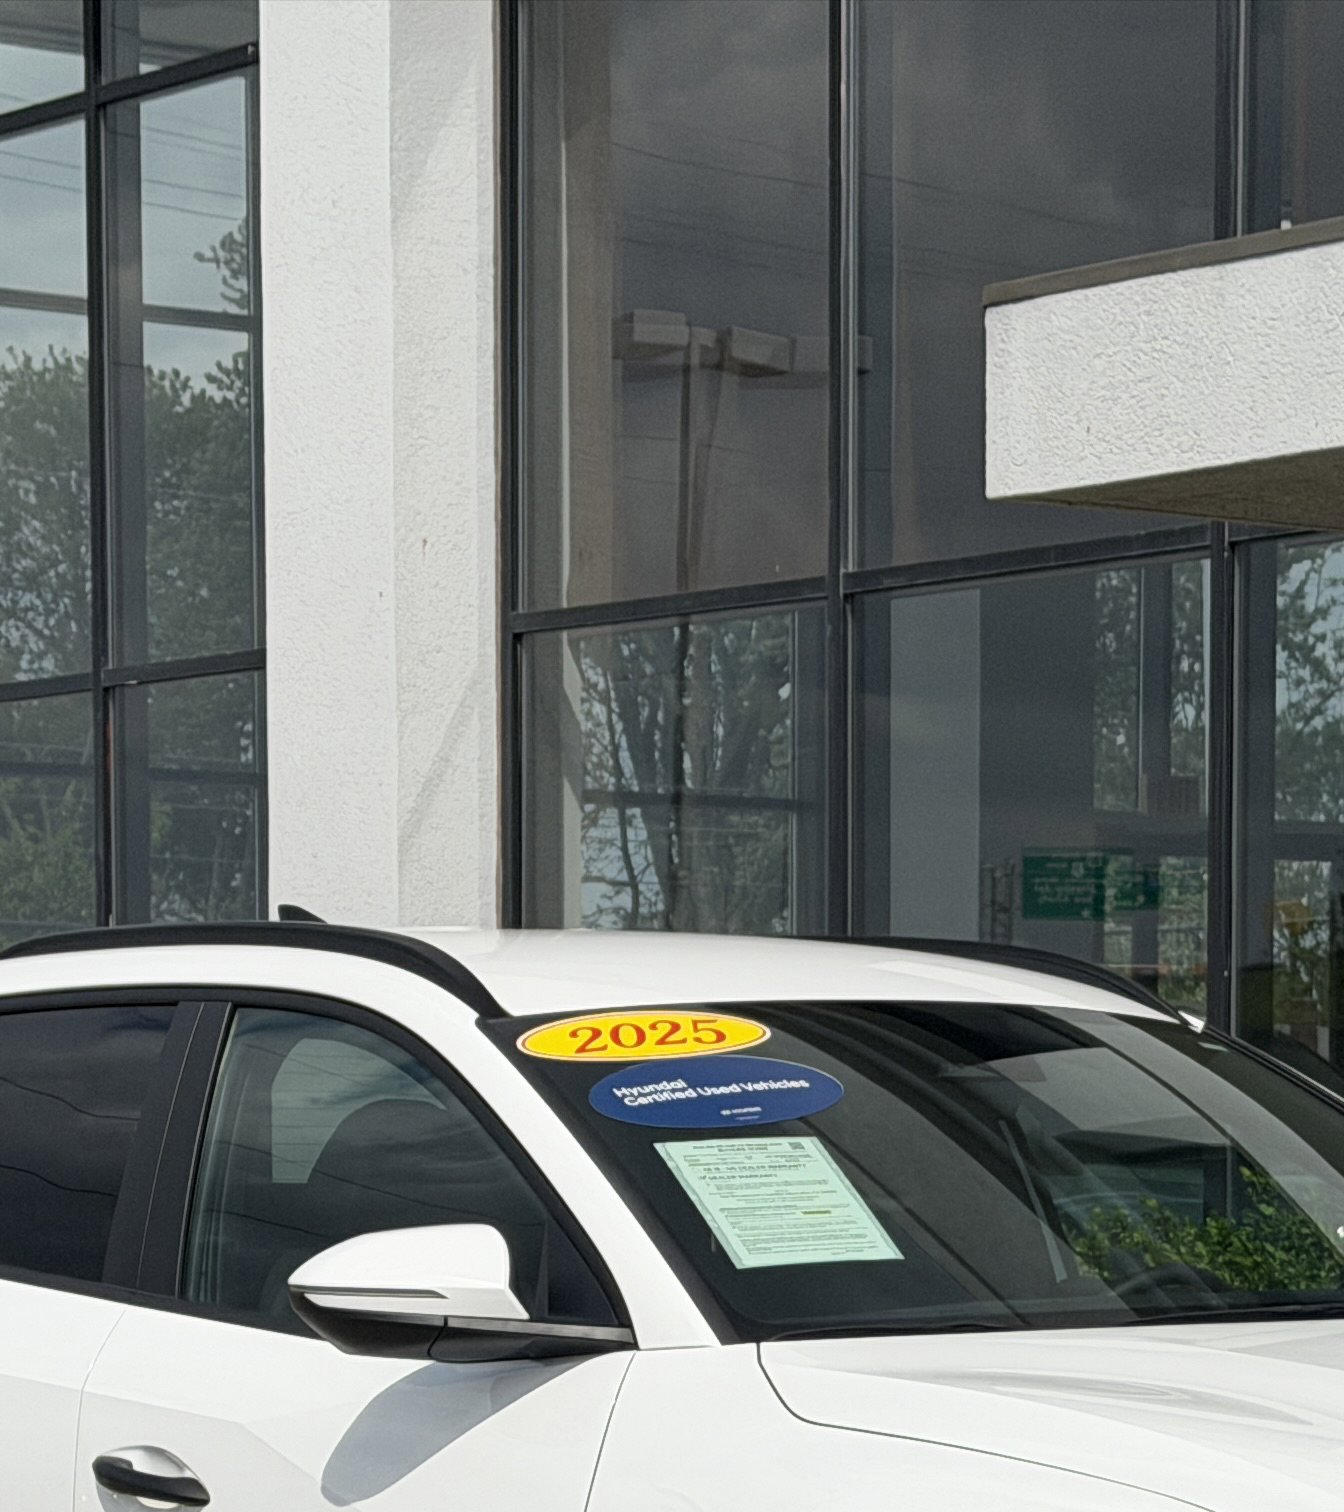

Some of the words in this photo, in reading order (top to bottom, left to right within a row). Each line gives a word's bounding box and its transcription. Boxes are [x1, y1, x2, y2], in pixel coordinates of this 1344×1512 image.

[569, 1018, 727, 1054] 2025
[613, 1078, 689, 1099] Hyundai
[622, 1085, 698, 1107] Certified
[696, 1082, 741, 1098] Used
[739, 1078, 811, 1094] Vehicles
